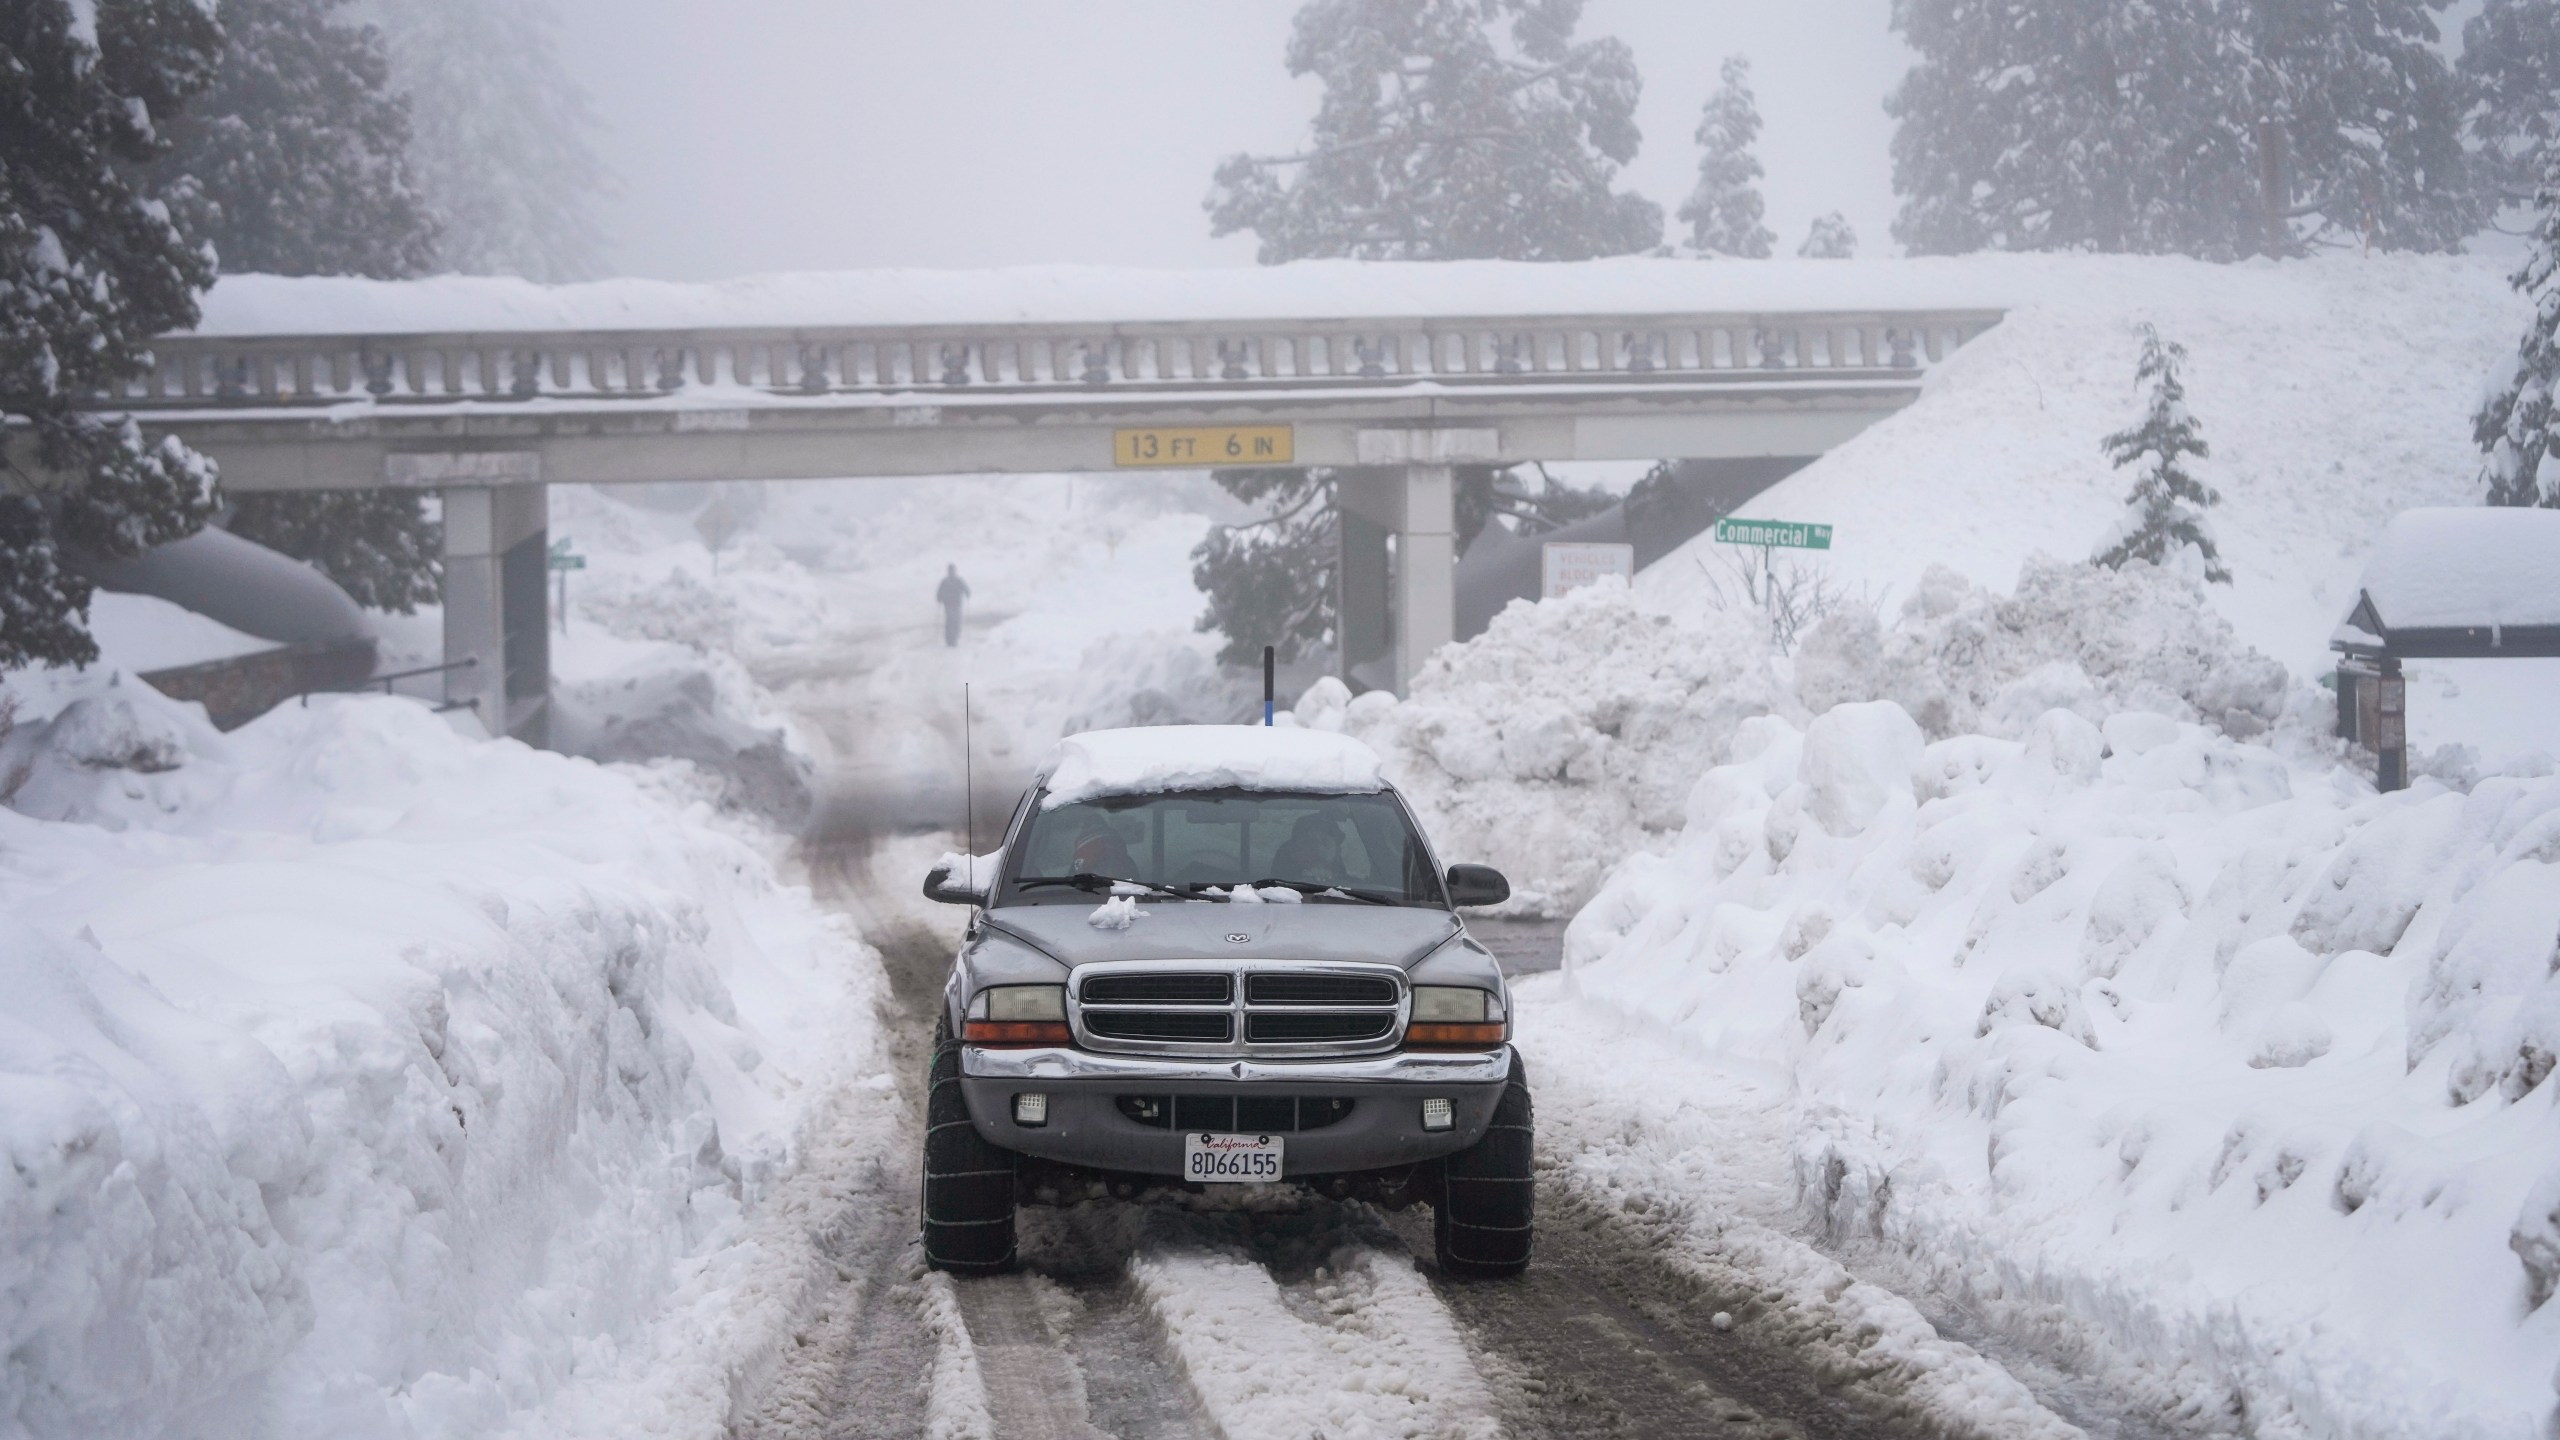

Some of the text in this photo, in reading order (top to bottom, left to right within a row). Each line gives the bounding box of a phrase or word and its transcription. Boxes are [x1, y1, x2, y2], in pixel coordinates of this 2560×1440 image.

[1132, 432, 1274, 458] 13 FT 6 IN
[1716, 518, 1832, 546] Commercial Way
[1560, 552, 1616, 566] VEHICLES
[1560, 568, 1616, 581] BLOCK
[1206, 1137, 1266, 1152] California
[1191, 1152, 1277, 1175] 8D66155
